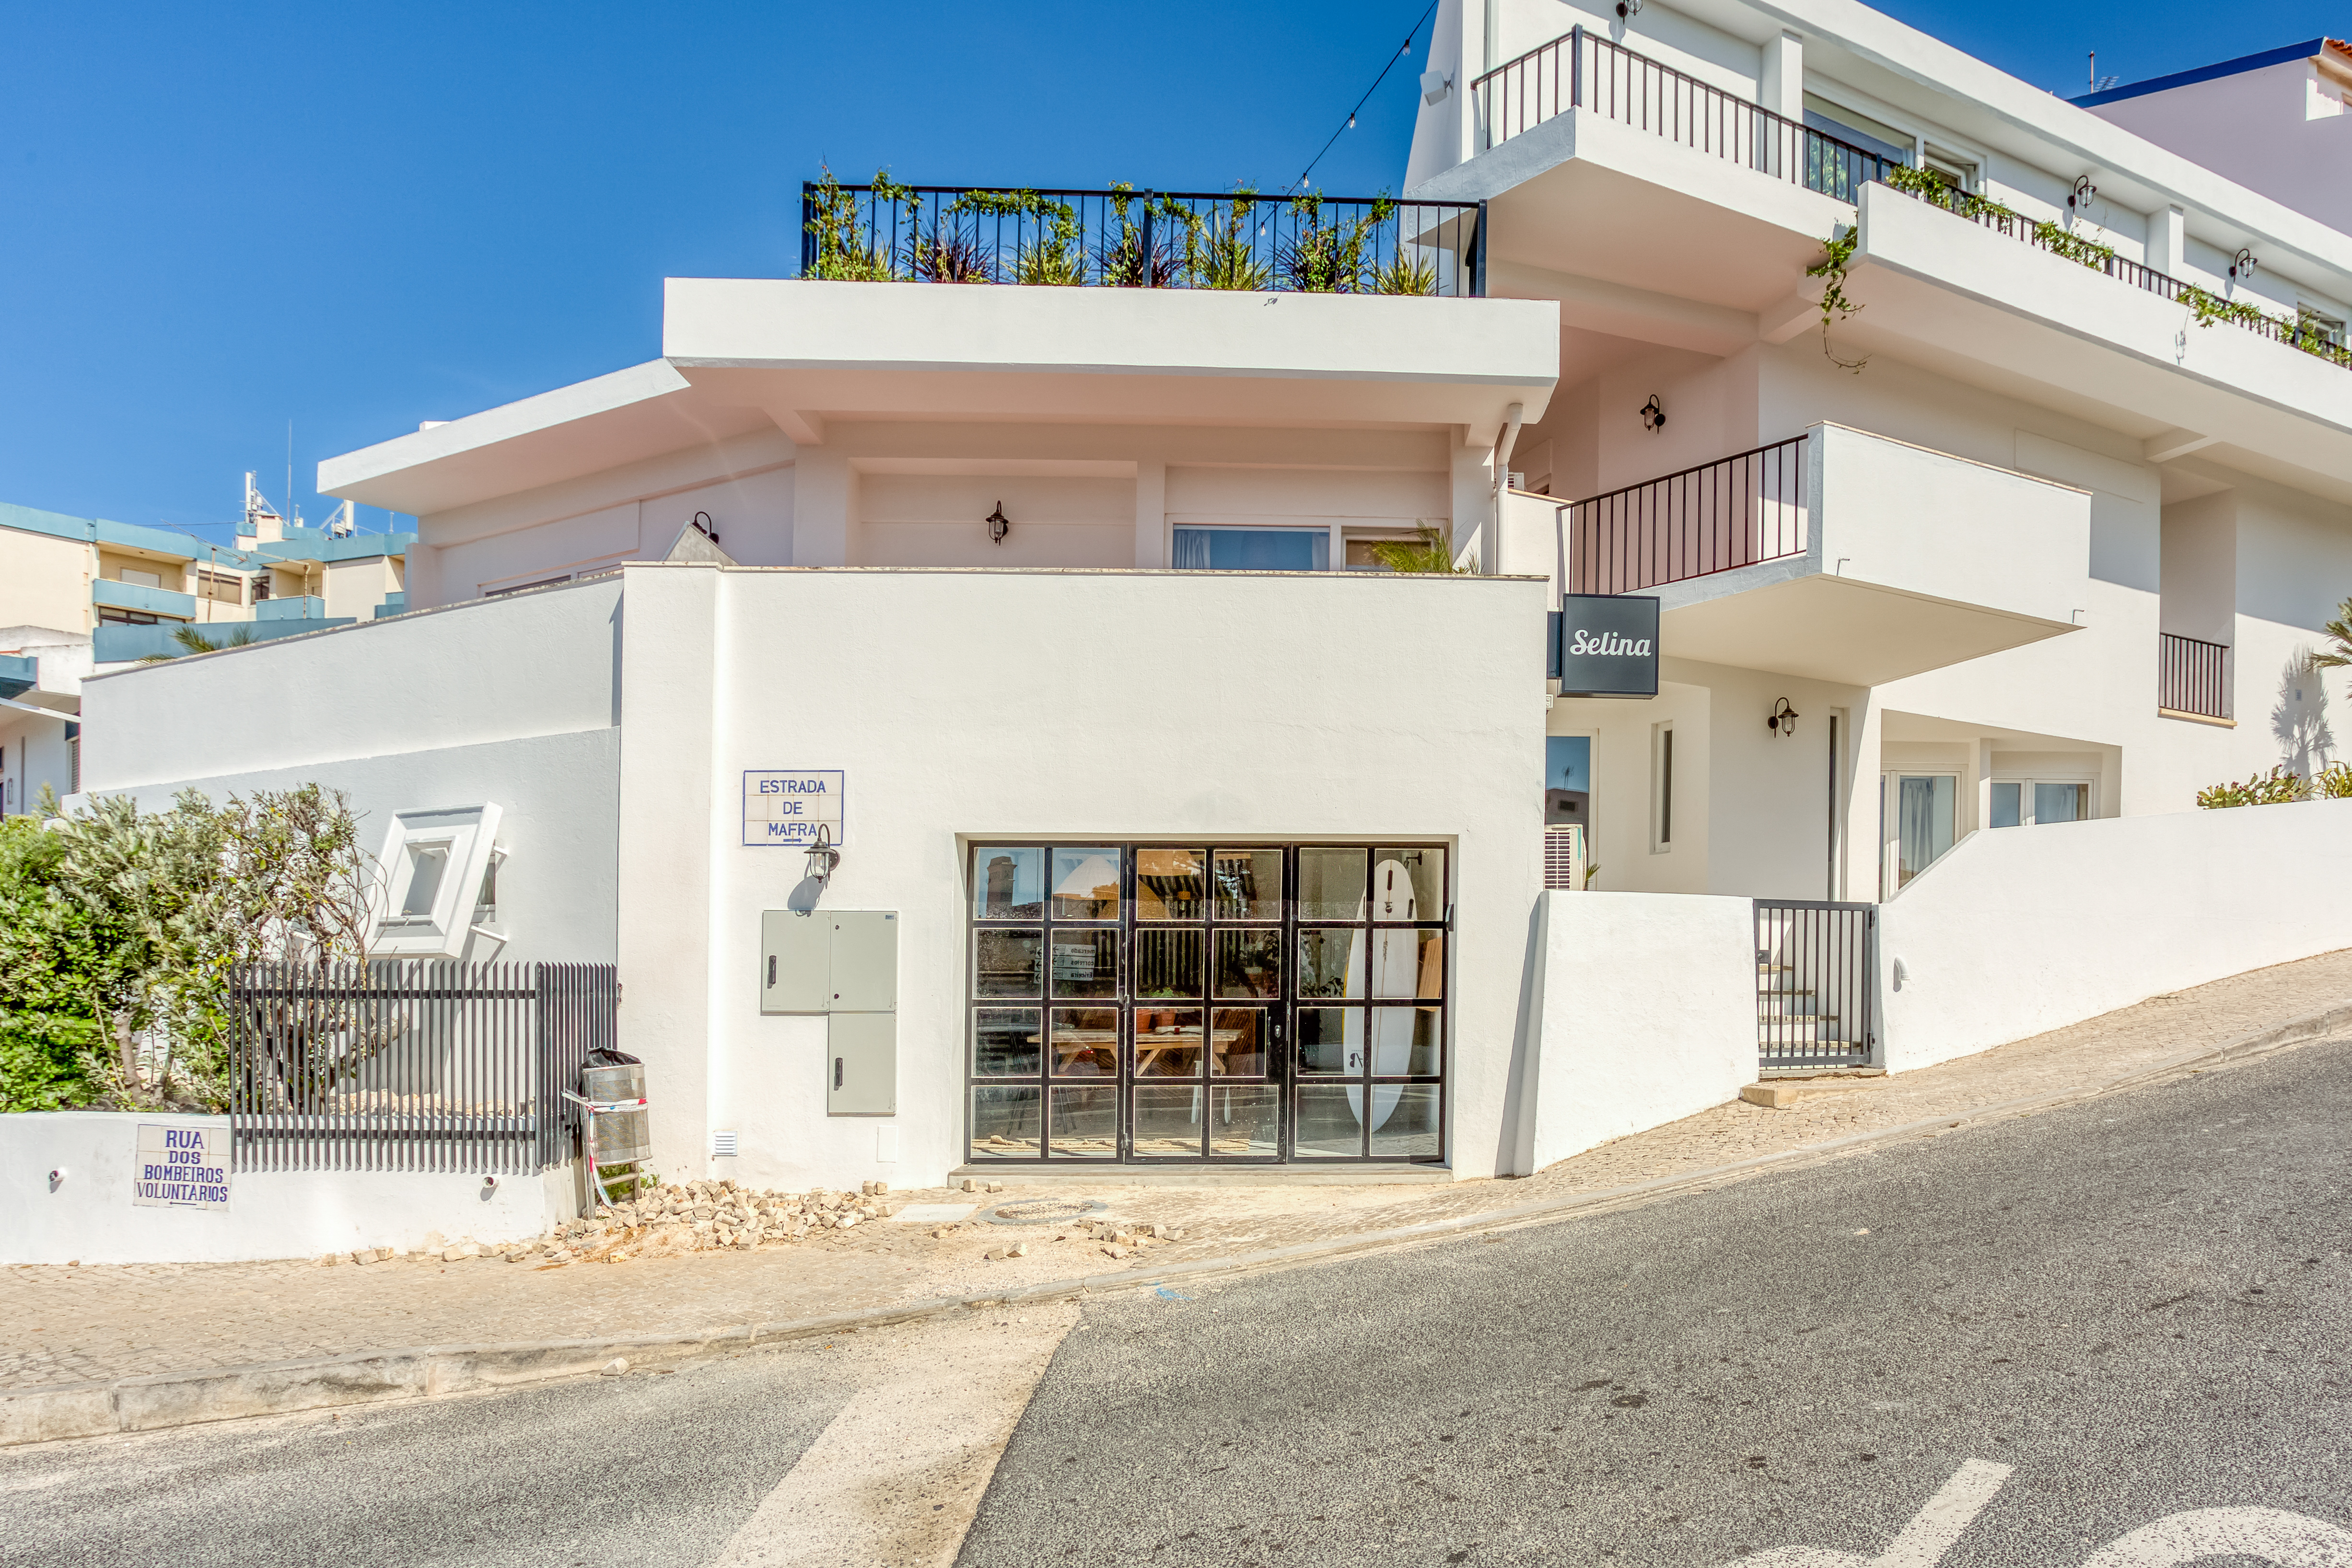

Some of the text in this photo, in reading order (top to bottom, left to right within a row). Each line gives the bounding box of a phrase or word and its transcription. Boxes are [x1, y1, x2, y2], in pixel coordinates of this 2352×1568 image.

[1570, 629, 1652, 657] Selina
[760, 780, 826, 793] ESTRADA
[783, 801, 803, 814] DE
[768, 823, 817, 836] MAFRA
[165, 1130, 204, 1149] RUA
[168, 1150, 201, 1164] DOS
[144, 1164, 223, 1183] BOMBEIROS
